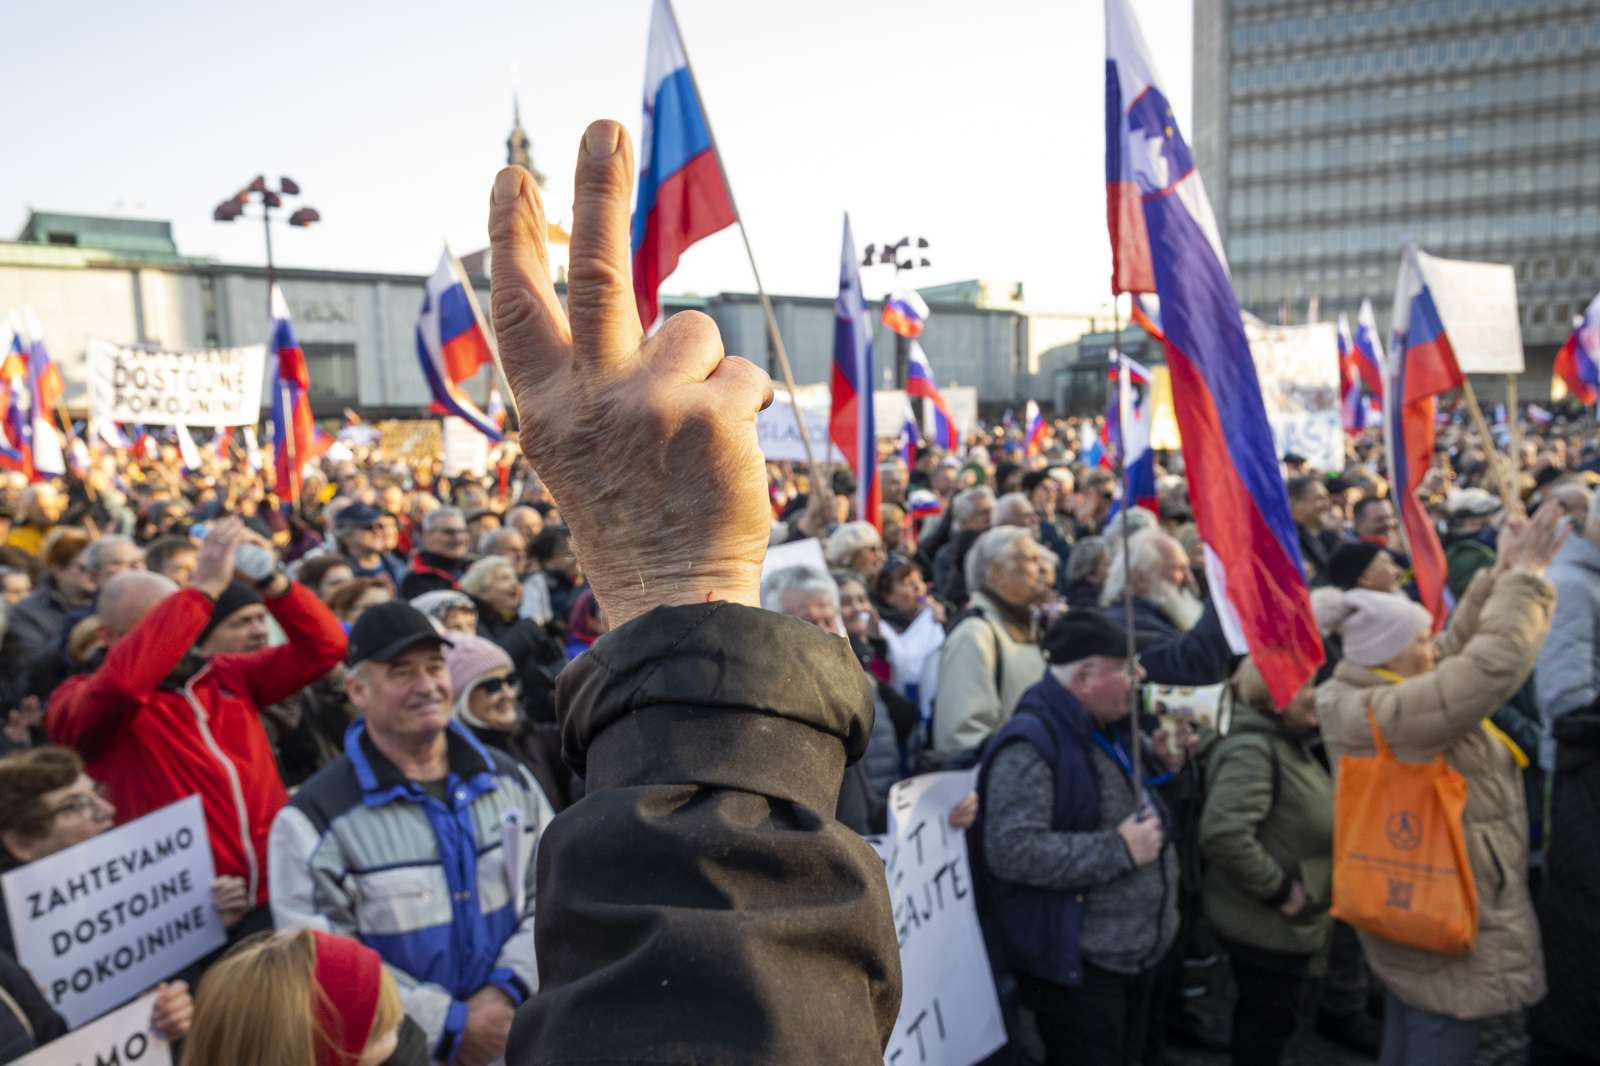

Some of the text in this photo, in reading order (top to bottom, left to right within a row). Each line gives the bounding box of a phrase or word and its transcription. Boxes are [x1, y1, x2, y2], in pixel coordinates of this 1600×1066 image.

[26, 827, 193, 919] ZAHTEVAMO
[51, 869, 193, 957] DOSTOJNE
[51, 905, 206, 1004] POKOJNINE
